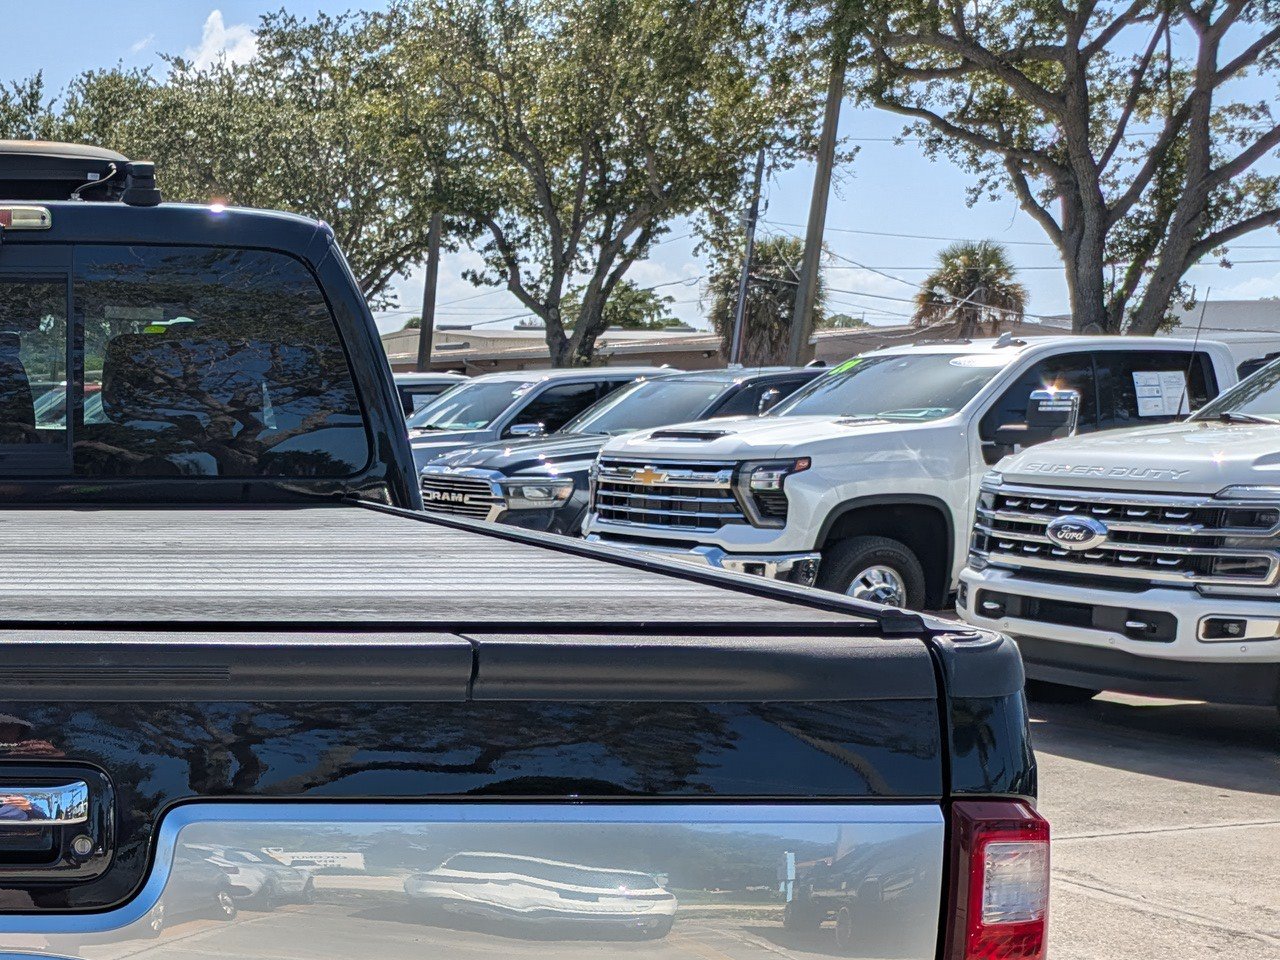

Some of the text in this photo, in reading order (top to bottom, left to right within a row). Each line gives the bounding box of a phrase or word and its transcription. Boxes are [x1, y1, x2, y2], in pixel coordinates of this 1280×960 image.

[1024, 461, 1192, 481] SUPER DUTY
[431, 491, 463, 502] RAM
[1055, 524, 1087, 542] Ford
